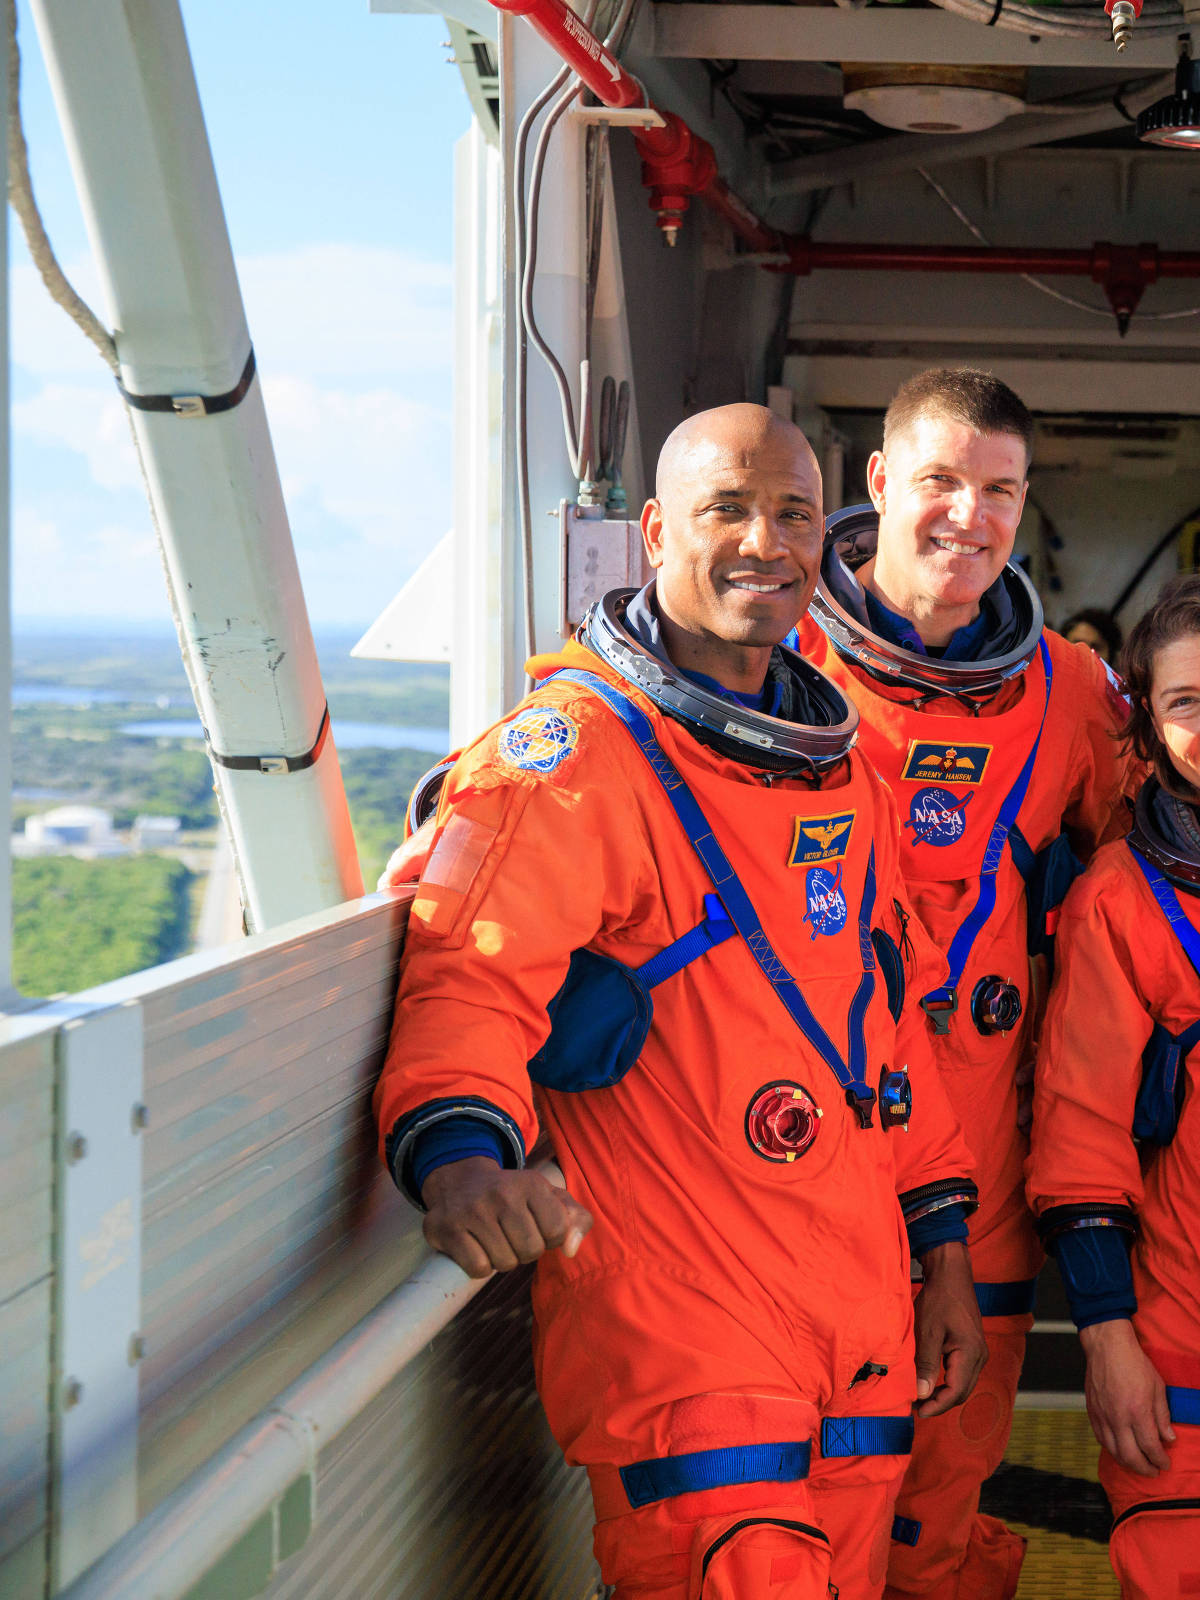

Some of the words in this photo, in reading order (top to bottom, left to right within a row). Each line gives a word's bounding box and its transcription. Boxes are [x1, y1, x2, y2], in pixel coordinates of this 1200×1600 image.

[915, 770, 942, 778] JEREMY
[945, 773, 972, 781] HANSEN
[914, 808, 963, 825] NASA
[809, 890, 844, 913] NASA
